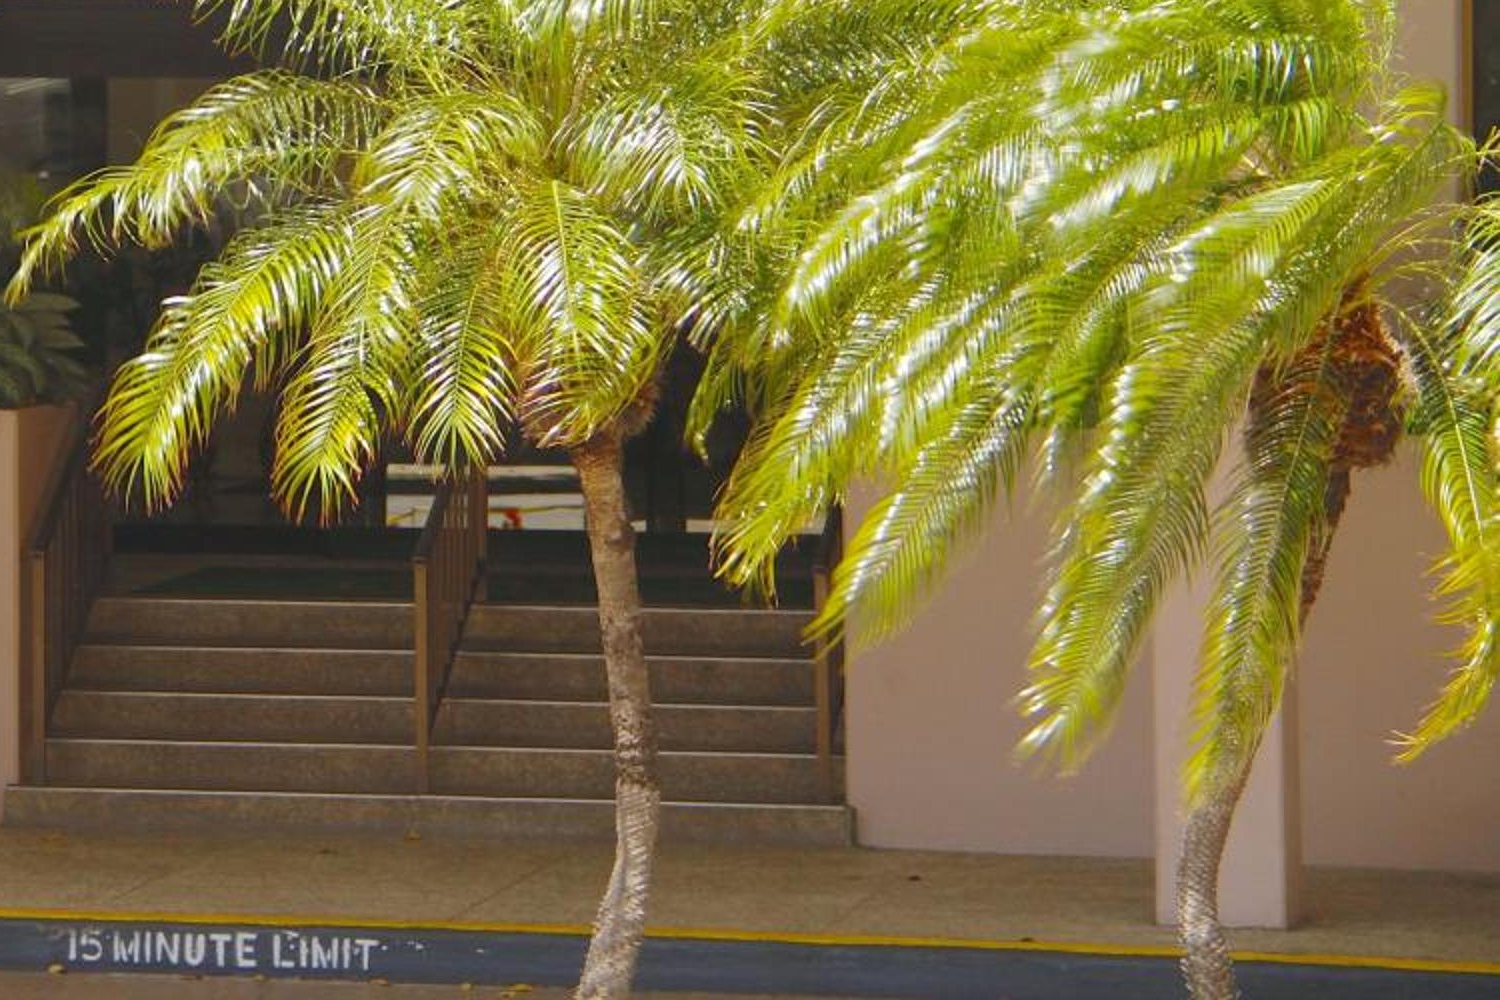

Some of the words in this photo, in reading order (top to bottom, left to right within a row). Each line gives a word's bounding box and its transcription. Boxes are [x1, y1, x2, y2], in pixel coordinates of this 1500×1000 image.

[67, 929, 103, 962] 15
[112, 931, 258, 969] MINUTE
[272, 932, 380, 971] LIMIT
